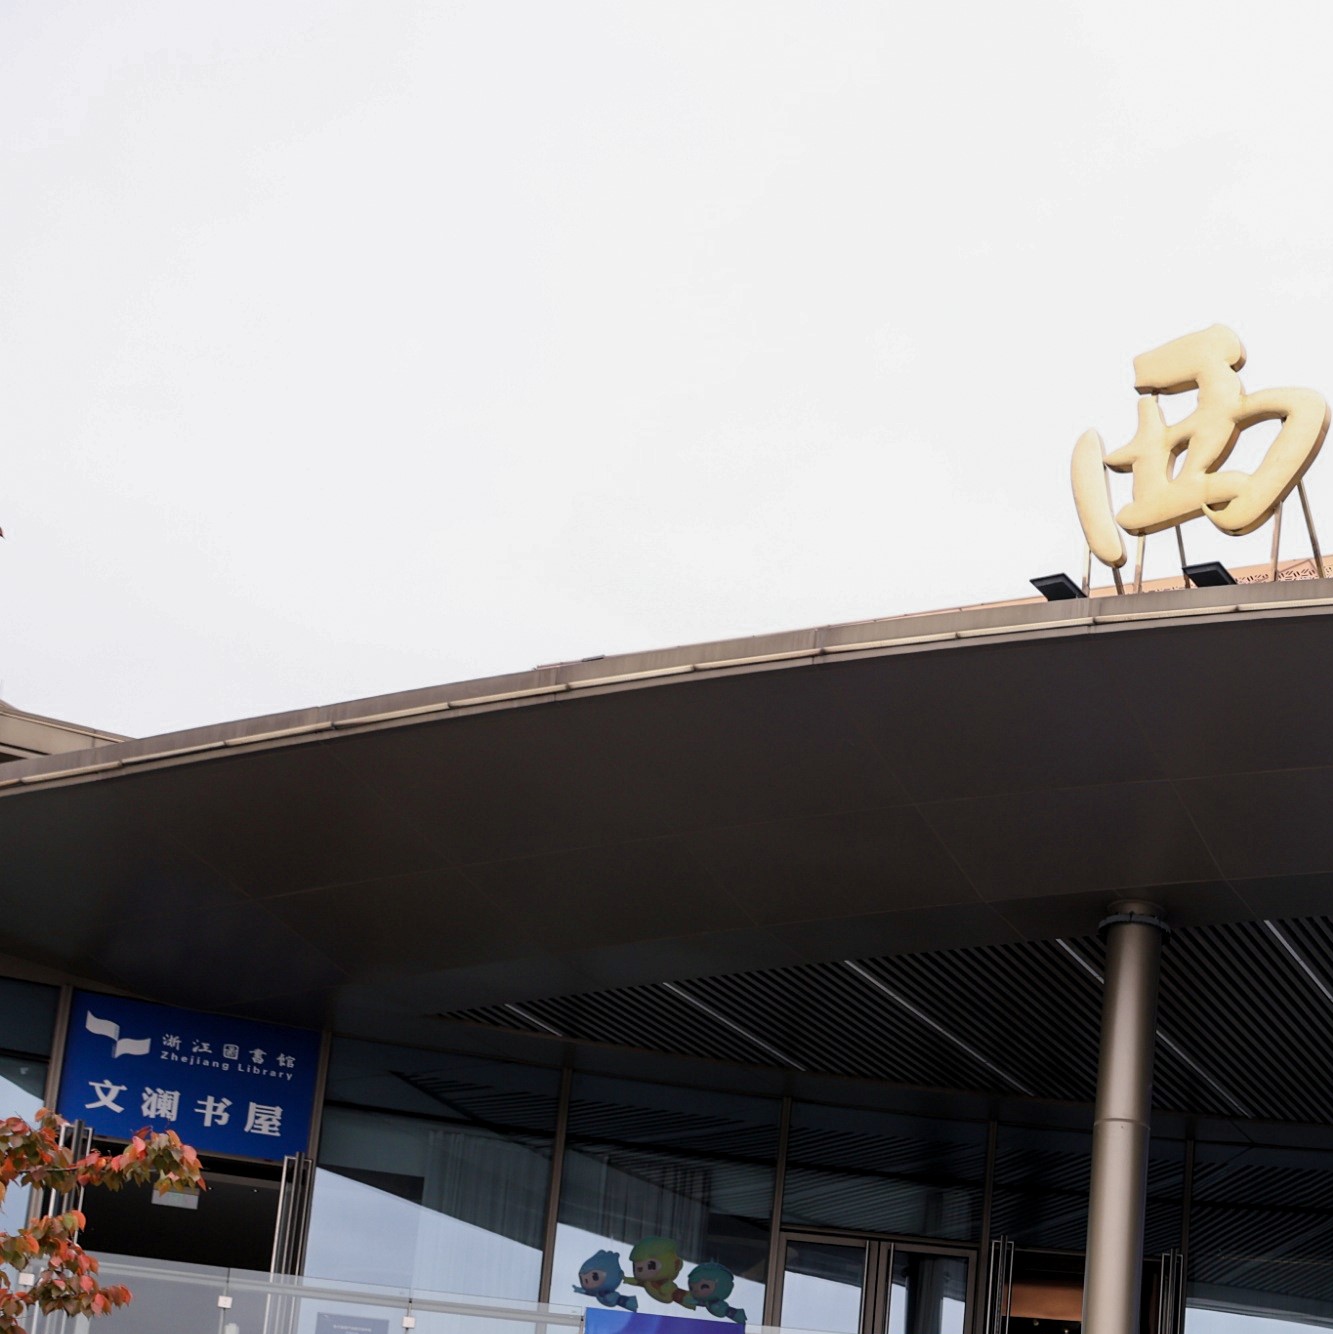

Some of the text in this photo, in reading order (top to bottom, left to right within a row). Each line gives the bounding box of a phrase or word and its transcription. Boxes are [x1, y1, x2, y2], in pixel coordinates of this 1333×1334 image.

[160, 1051, 293, 1081] Zhejiang Library
[85, 1079, 284, 1137] 文澜书屋
